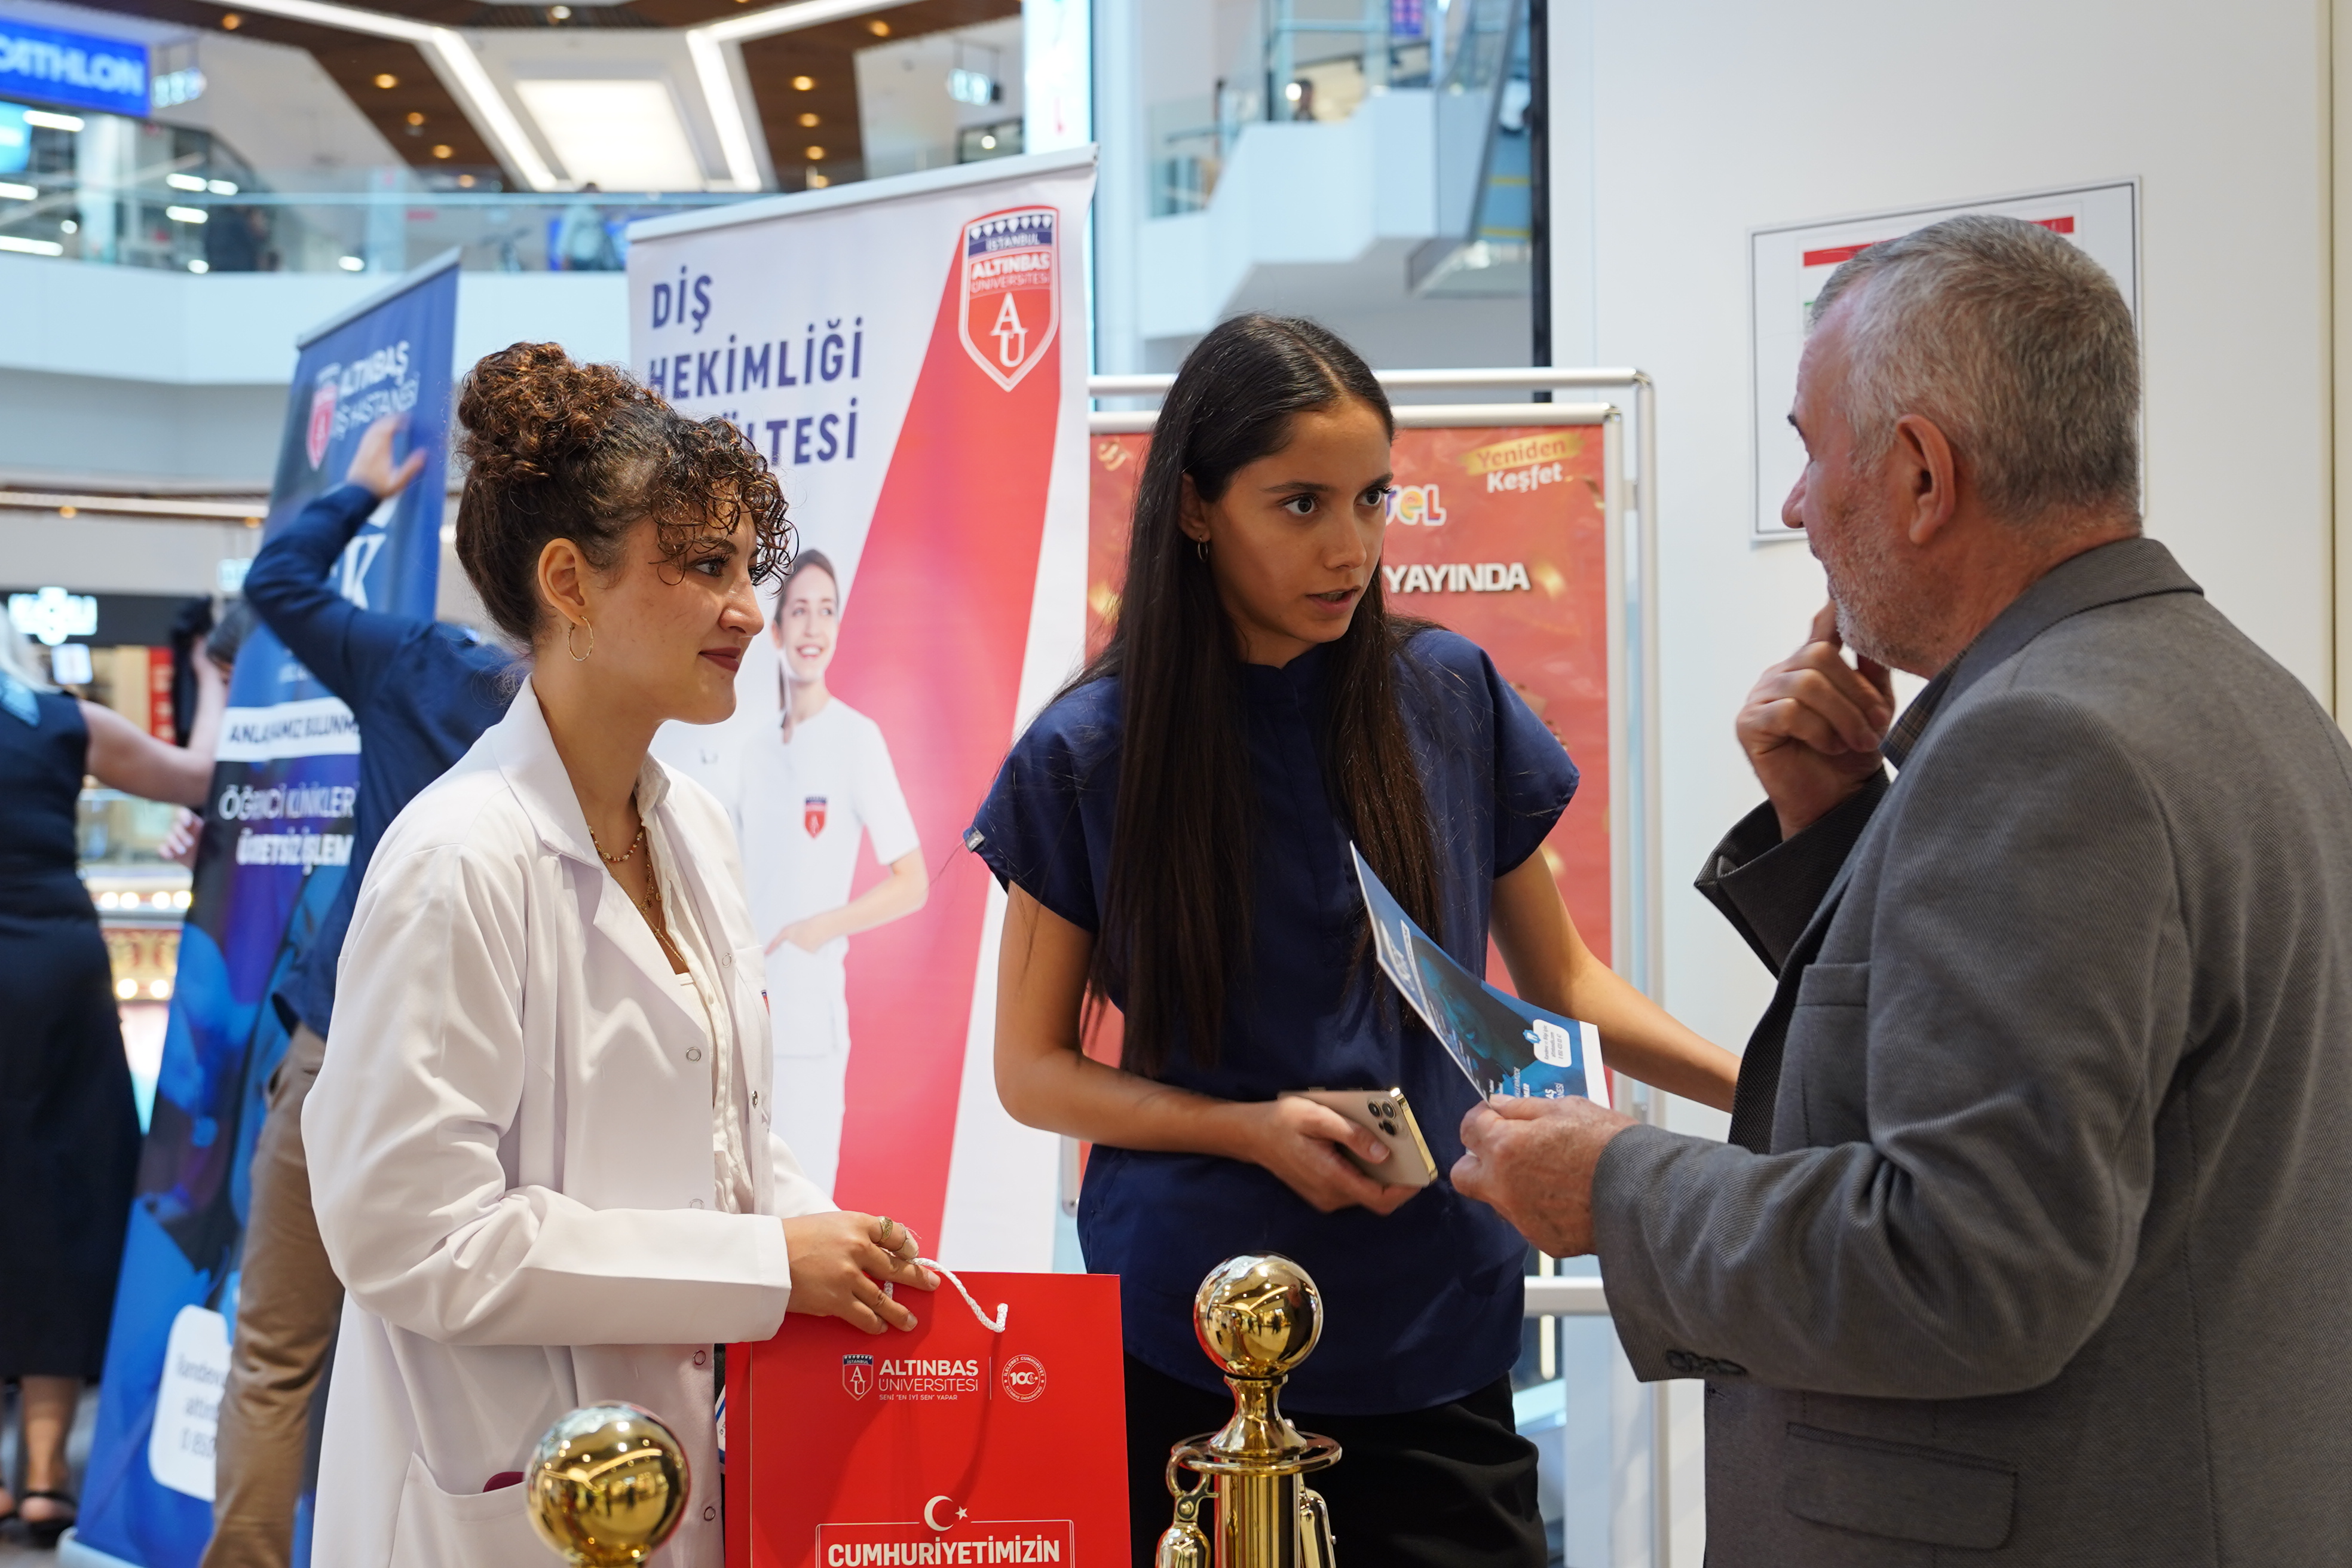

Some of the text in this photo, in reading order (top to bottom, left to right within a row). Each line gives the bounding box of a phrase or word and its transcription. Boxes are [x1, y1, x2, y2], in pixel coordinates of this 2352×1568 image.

[652, 265, 712, 334] DİŞ
[650, 317, 862, 399] HEKİMLİĞİ
[1477, 439, 1567, 469] Yeniden
[1487, 462, 1563, 493] Keşfet
[1382, 563, 1531, 593] YAYINDA
[828, 1535, 1060, 1567] CUMHURİYETİMİZİN
